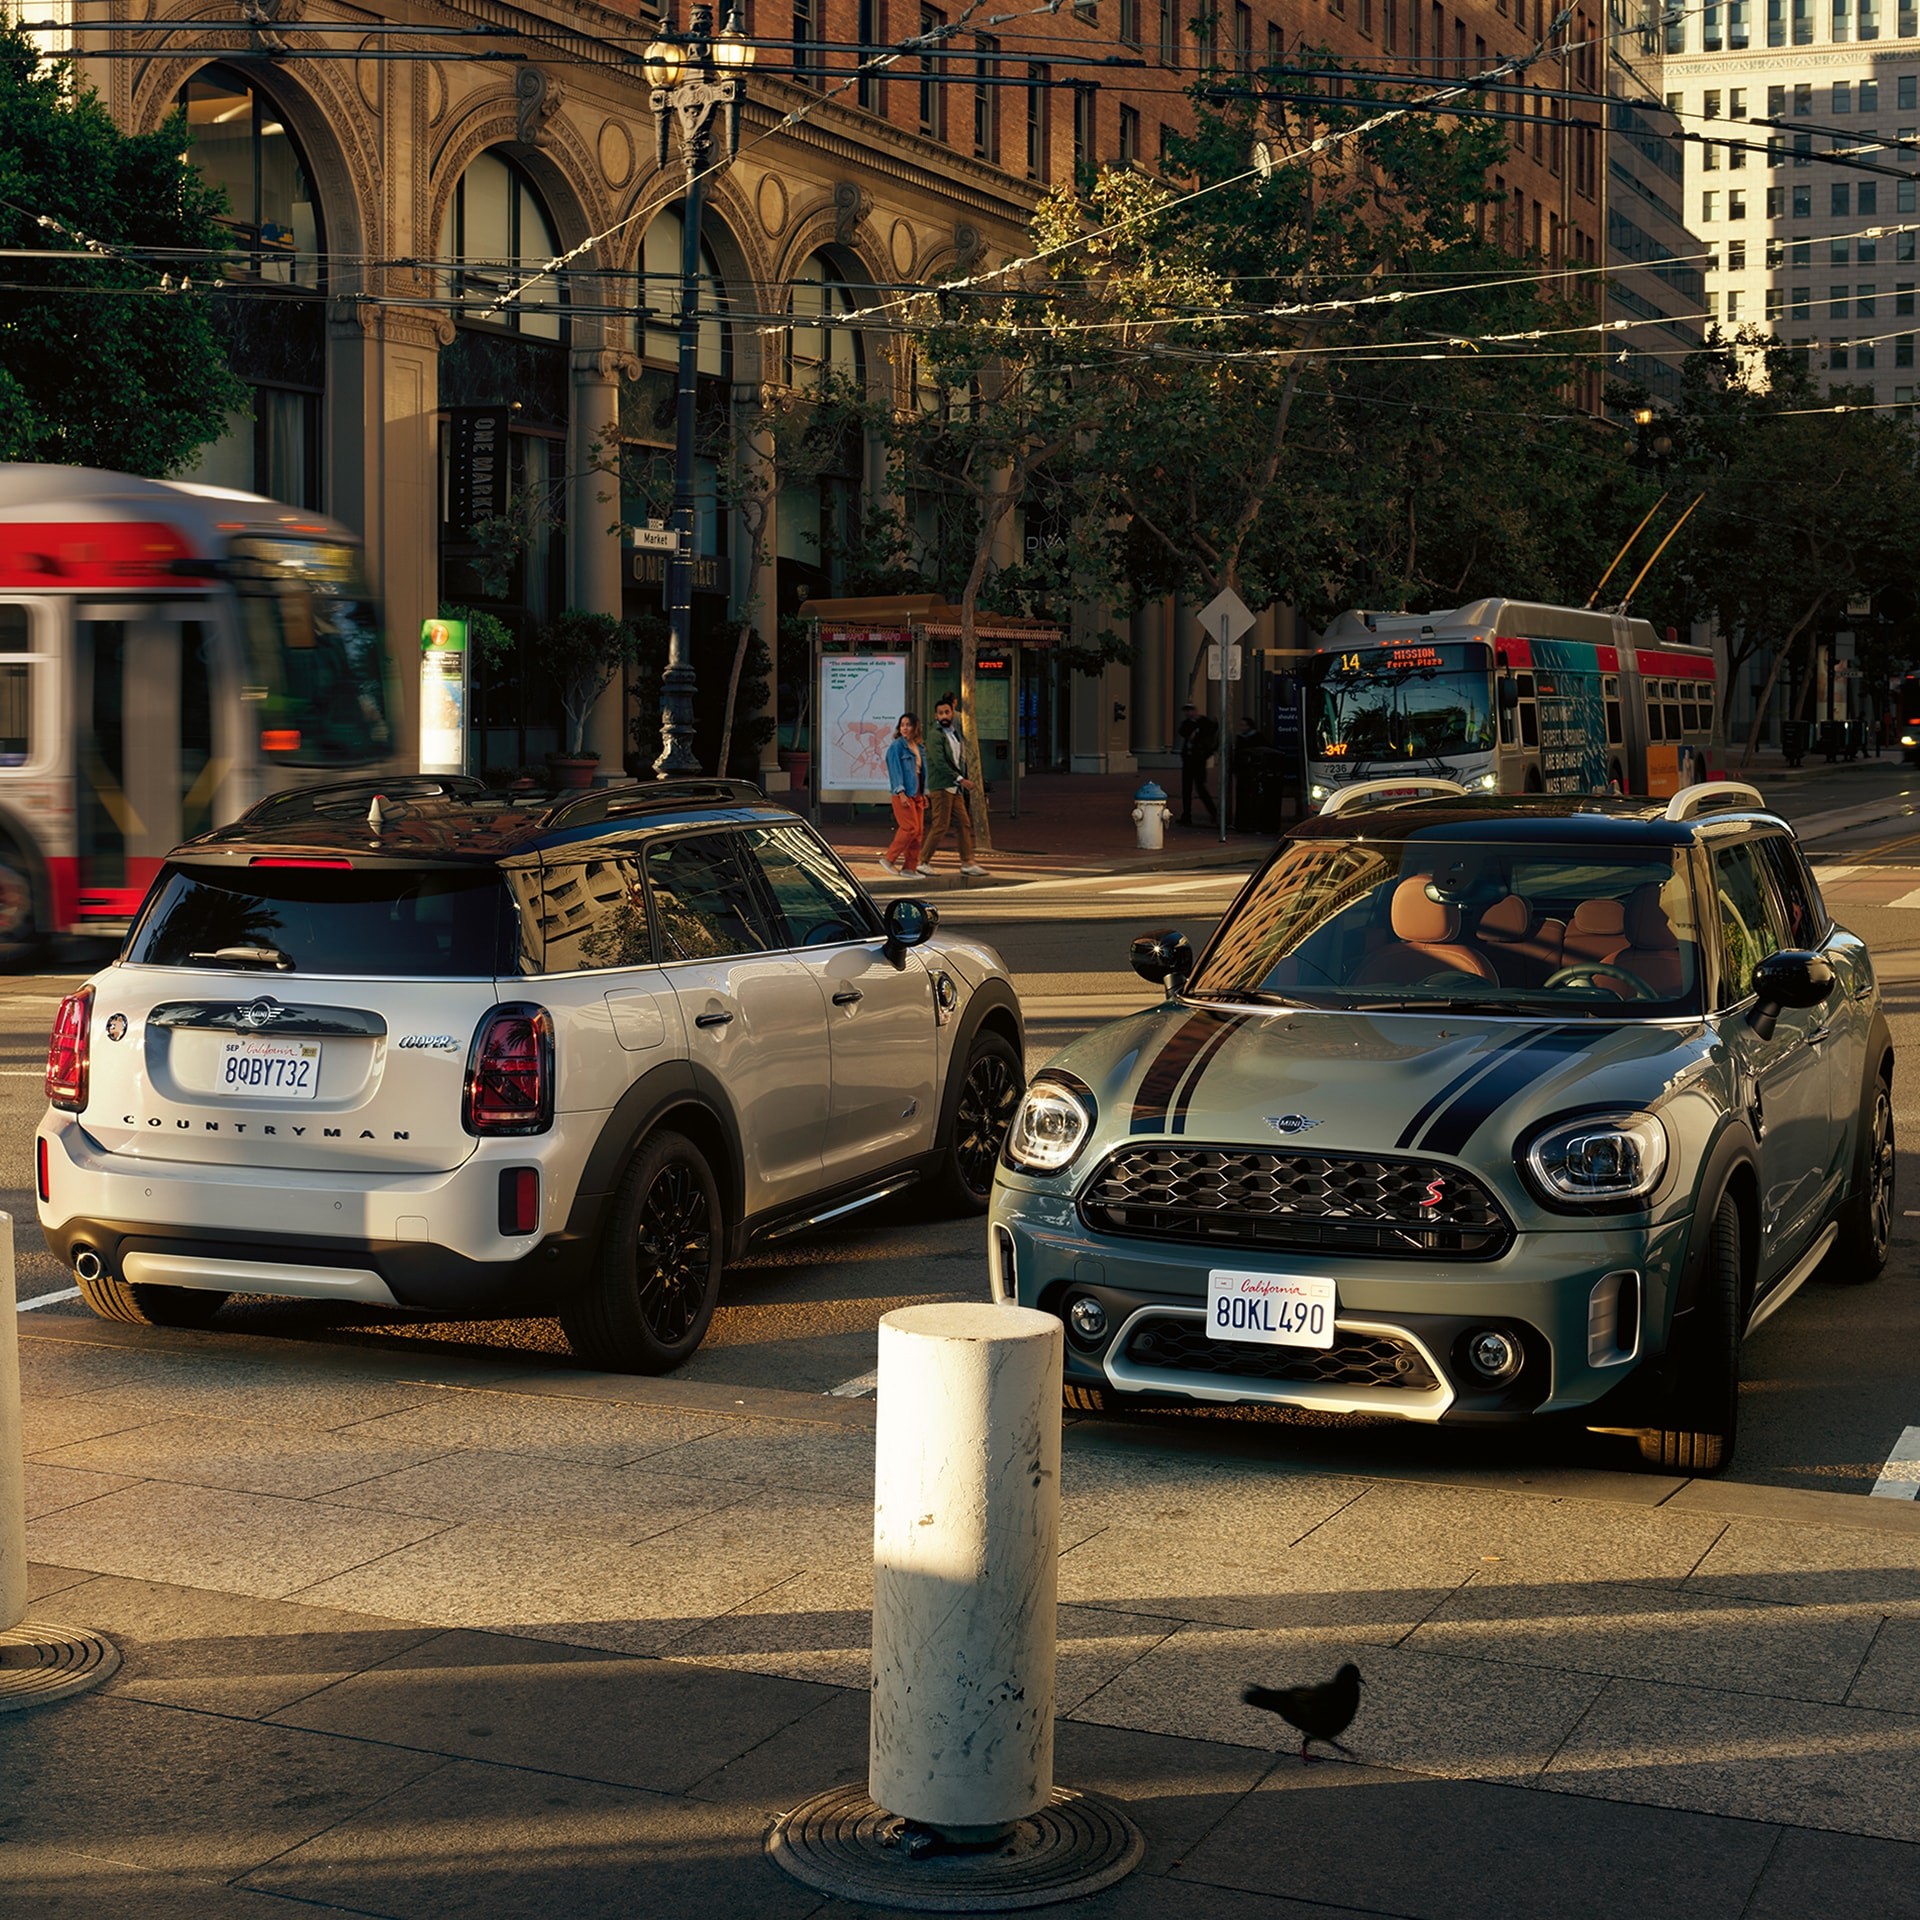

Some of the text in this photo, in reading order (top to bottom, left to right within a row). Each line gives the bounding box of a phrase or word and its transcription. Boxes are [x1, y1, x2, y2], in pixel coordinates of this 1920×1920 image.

[471, 417, 496, 521] ONE MARKE
[643, 532, 668, 546] Market
[633, 554, 665, 583] ONE
[1341, 652, 1361, 671] 14
[1393, 647, 1435, 660] MISSION
[1417, 657, 1443, 666] Plaza
[1326, 744, 1348, 756] 347
[1324, 764, 1347, 773] 7236
[1545, 751, 1583, 769] ARE BIG FANS OF
[1546, 777, 1560, 793] MASS
[1560, 775, 1580, 792] TRANSIT
[226, 1044, 240, 1052] SEP
[246, 1042, 298, 1057] California
[398, 1035, 450, 1048] COOPER
[225, 1057, 309, 1087] 8QBY732
[123, 1114, 410, 1140] COUNTRYMAN
[1241, 1278, 1307, 1297] California
